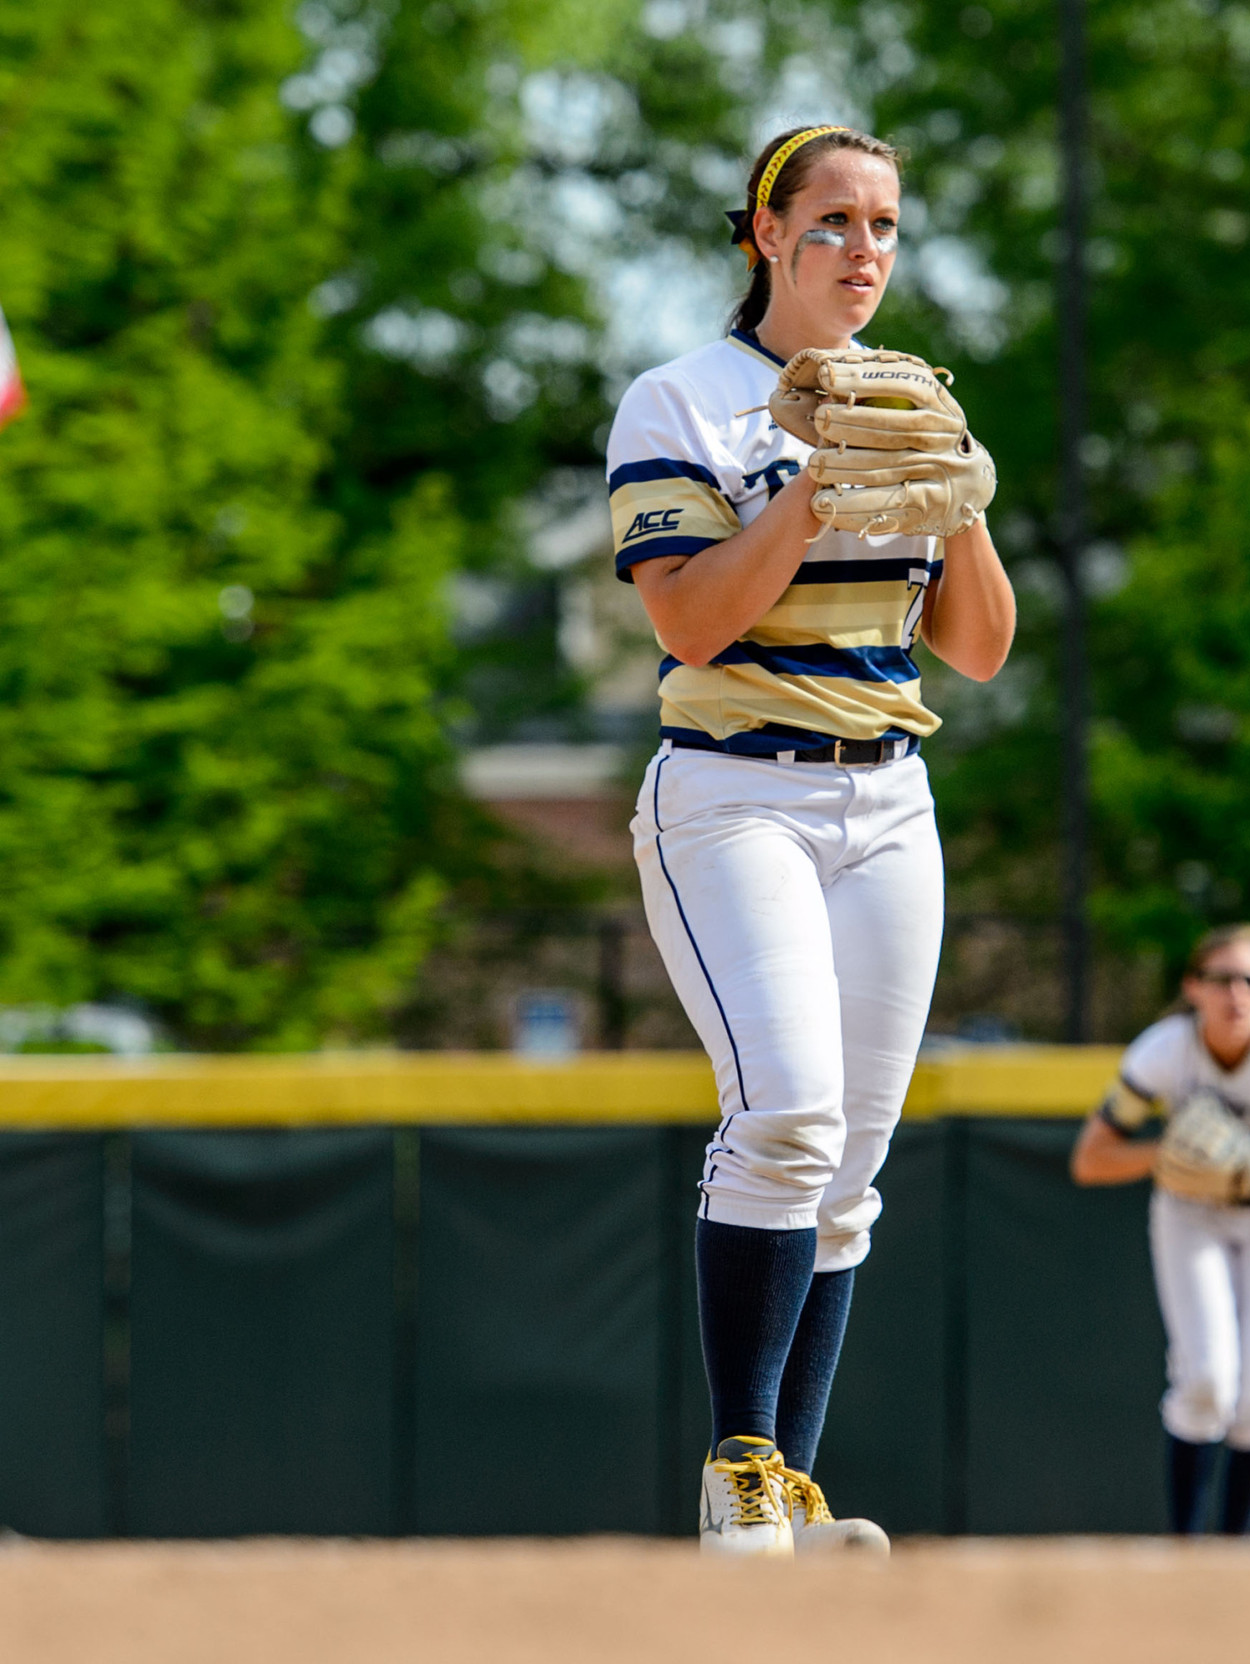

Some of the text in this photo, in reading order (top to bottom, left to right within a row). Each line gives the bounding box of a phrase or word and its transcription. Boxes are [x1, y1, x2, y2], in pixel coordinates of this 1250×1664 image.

[862, 371, 933, 387] WORTH
[622, 508, 685, 544] ACC
[900, 567, 931, 651] 7
